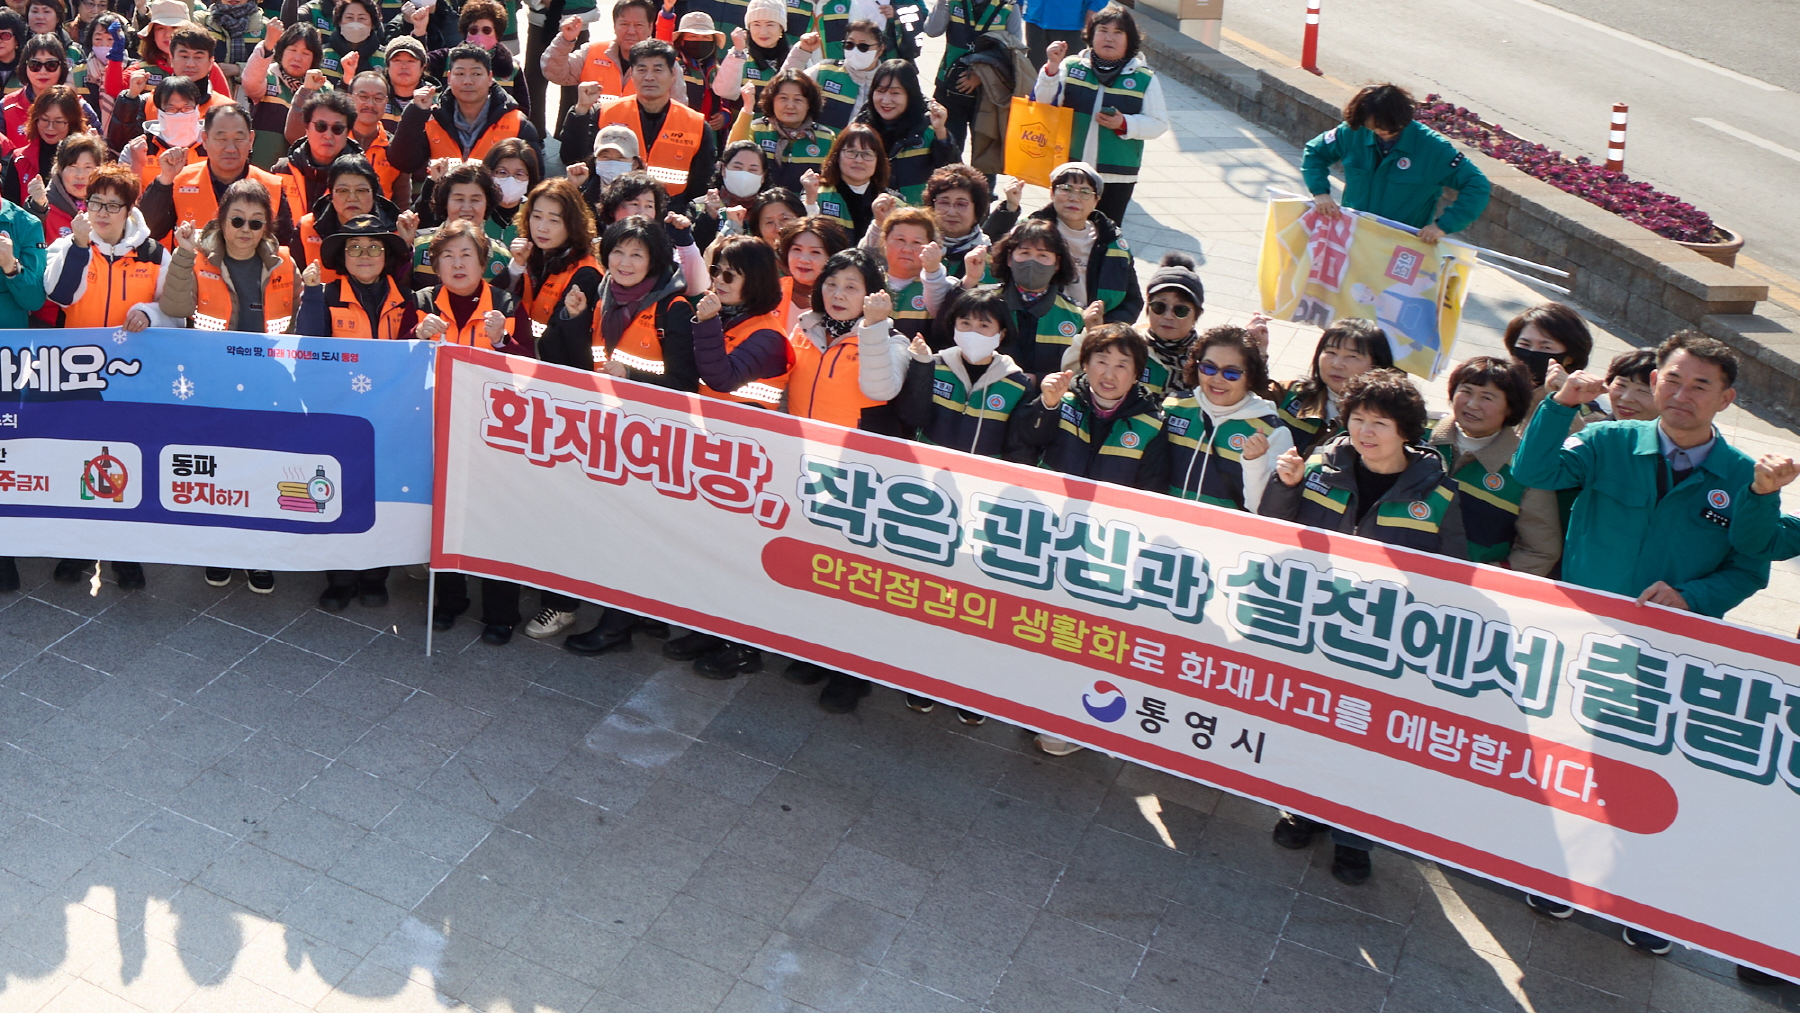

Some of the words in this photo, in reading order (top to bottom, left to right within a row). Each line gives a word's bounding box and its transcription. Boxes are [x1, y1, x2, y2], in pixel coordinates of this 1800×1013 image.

[1021, 130, 1049, 148] Kelly
[336, 319, 356, 330] 통영
[226, 345, 252, 357] 약속의
[253, 346, 266, 358] 땅,
[267, 348, 286, 359] 미래
[286, 349, 320, 362] 100년의
[321, 351, 340, 363] 도시
[341, 352, 360, 363] 통영
[171, 453, 218, 479] 동파
[171, 481, 250, 509] 방지하기
[485, 385, 786, 528] 화재예방,
[802, 459, 957, 565] 작은
[970, 496, 1212, 621] 관심과
[1224, 555, 1560, 714] 실전에서
[811, 551, 997, 630] 안전점검의
[1011, 603, 1167, 676] 생활화로
[1177, 649, 1373, 737] 화재사고를
[1386, 709, 1607, 807] 예방합시다.
